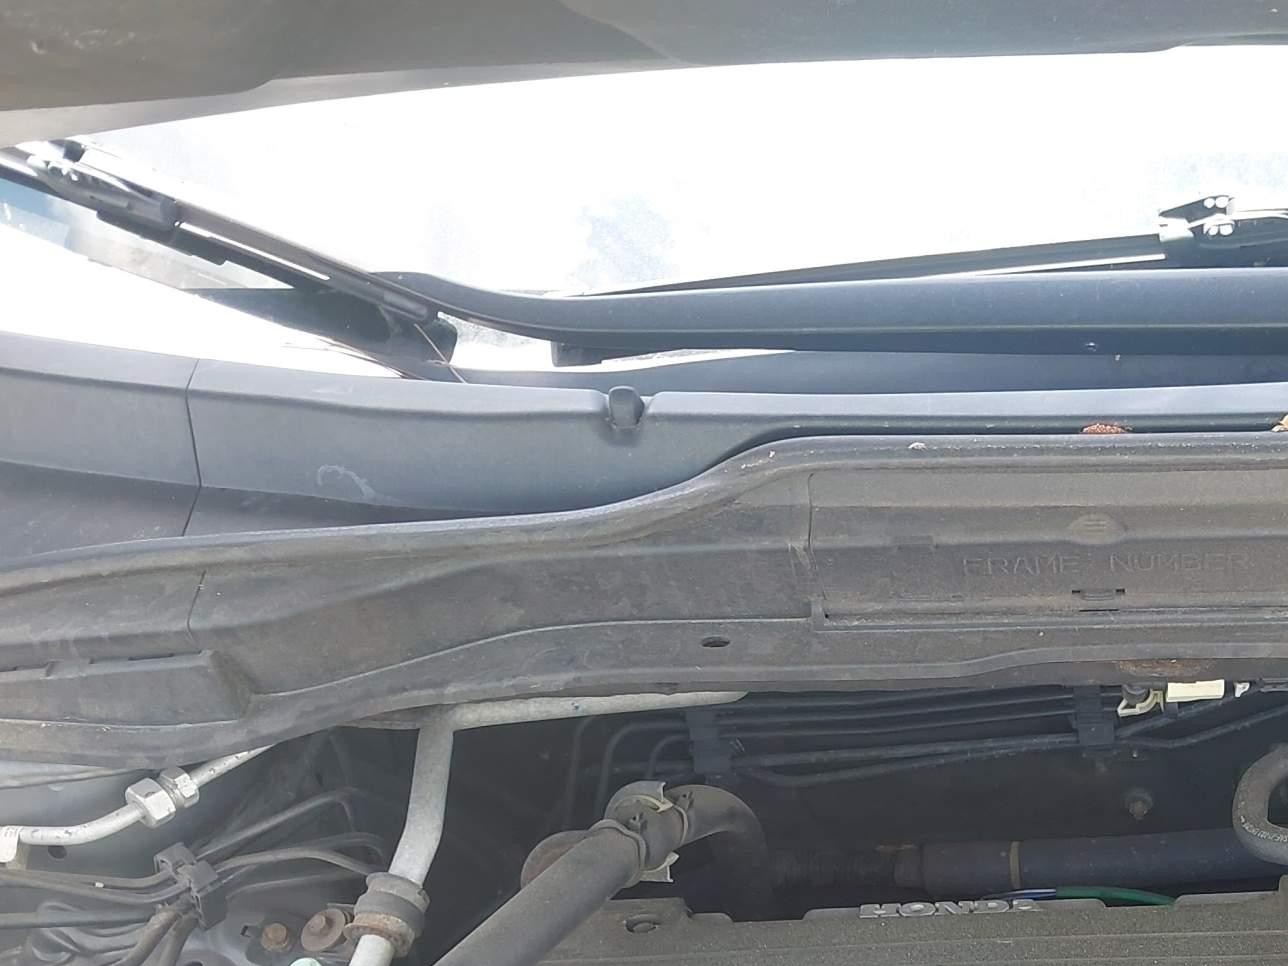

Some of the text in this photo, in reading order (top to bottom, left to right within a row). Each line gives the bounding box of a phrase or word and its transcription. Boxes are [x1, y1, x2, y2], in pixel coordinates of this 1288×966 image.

[961, 551, 1254, 576] FRAME NUMBER
[859, 899, 1043, 918] HONDA
